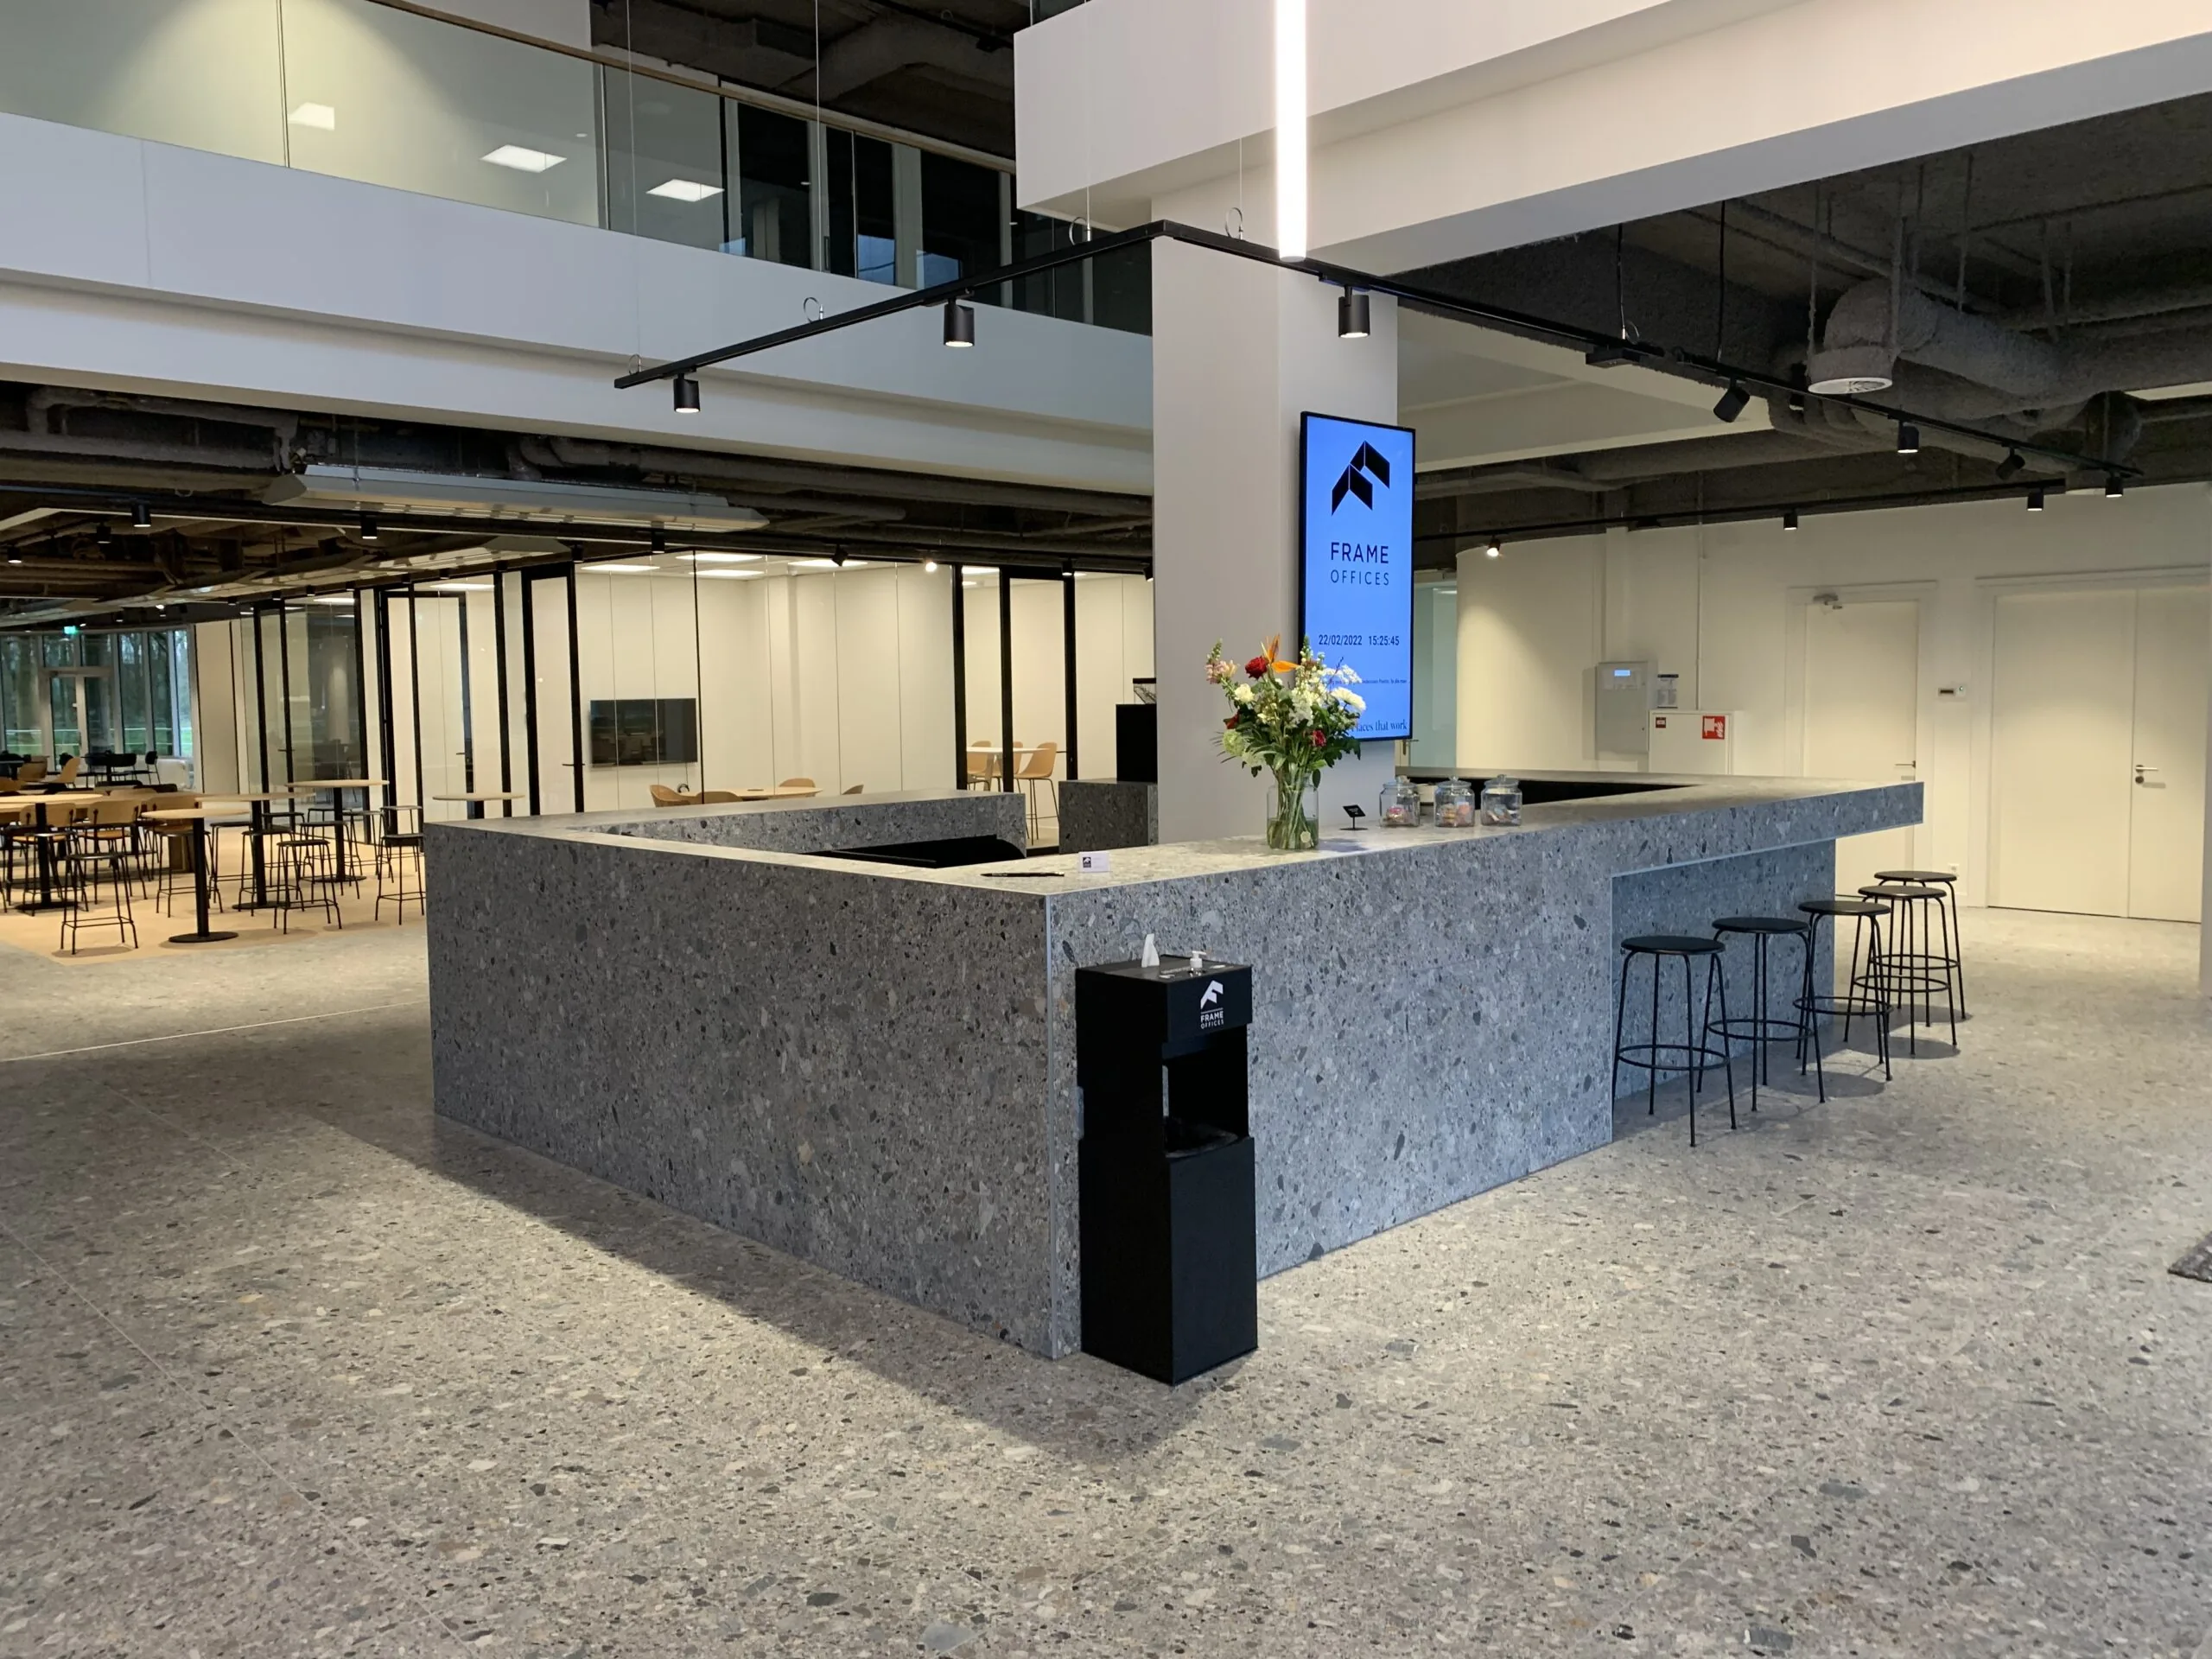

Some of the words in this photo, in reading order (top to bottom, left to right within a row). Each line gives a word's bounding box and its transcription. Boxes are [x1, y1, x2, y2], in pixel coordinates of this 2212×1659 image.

[1331, 542, 1389, 564] FRAME
[1331, 569, 1389, 586] OFFICES
[1319, 634, 1363, 646] 22/02/2022
[1368, 635, 1400, 646] 15:25:45
[1376, 720, 1389, 731] that
[1390, 719, 1408, 731] work
[1200, 1011, 1224, 1023] FRAME
[1200, 1019, 1224, 1029] OFFICES
